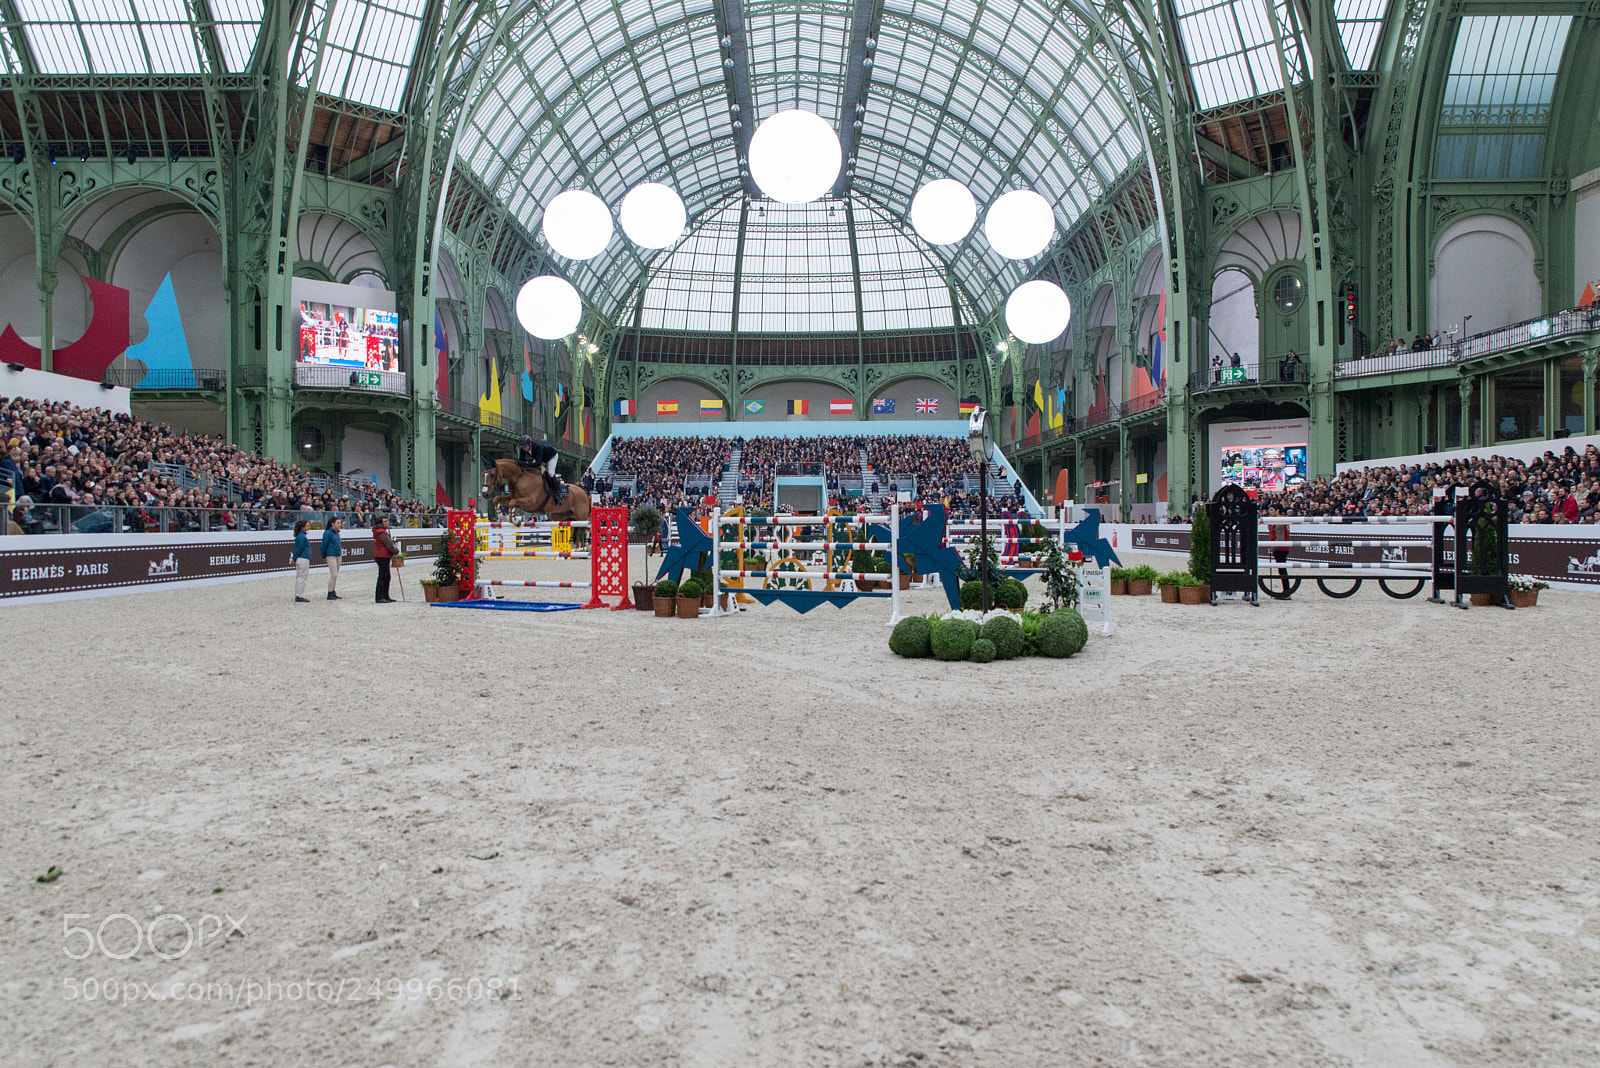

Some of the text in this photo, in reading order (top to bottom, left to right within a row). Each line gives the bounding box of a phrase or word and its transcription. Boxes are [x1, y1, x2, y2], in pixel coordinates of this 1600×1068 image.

[351, 548, 364, 556] PARIS
[1334, 546, 1354, 555] PARIS
[210, 554, 240, 566] HERMÈS
[246, 553, 266, 563] PARIS
[12, 564, 64, 581] HERMÈS
[76, 563, 109, 576] PARIS
